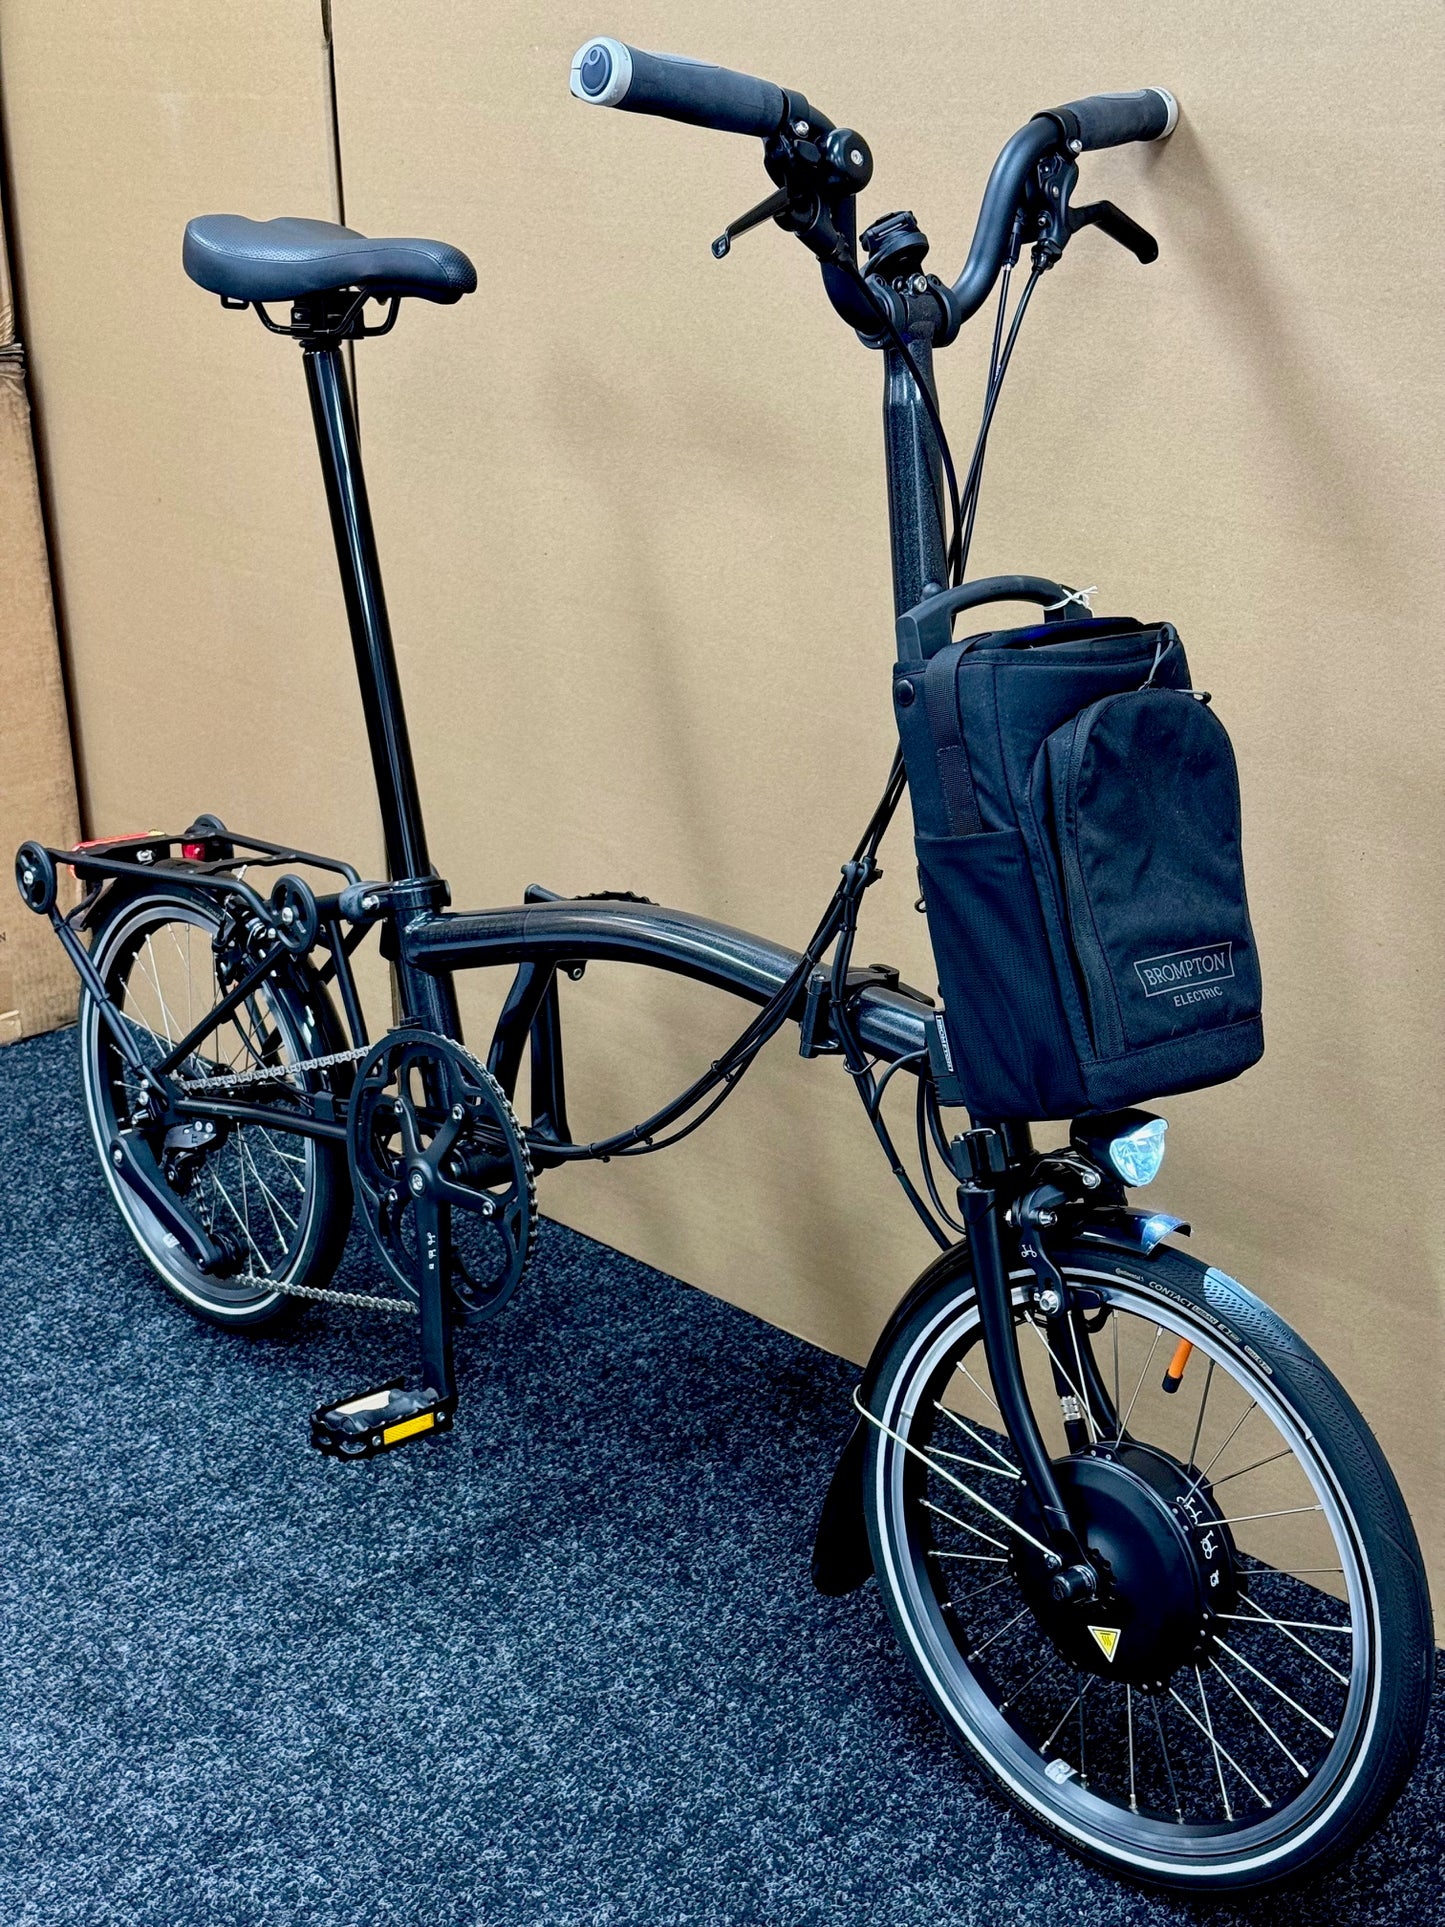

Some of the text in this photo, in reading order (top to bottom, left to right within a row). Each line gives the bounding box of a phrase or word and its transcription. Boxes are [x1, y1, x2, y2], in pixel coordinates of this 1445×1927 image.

[1143, 952, 1225, 986] BROMPTON
[1173, 986, 1223, 1007] ELECTRIC
[1148, 1281, 1193, 1308] CONTACT
[996, 1776, 1056, 1829] CONTINENTAL
